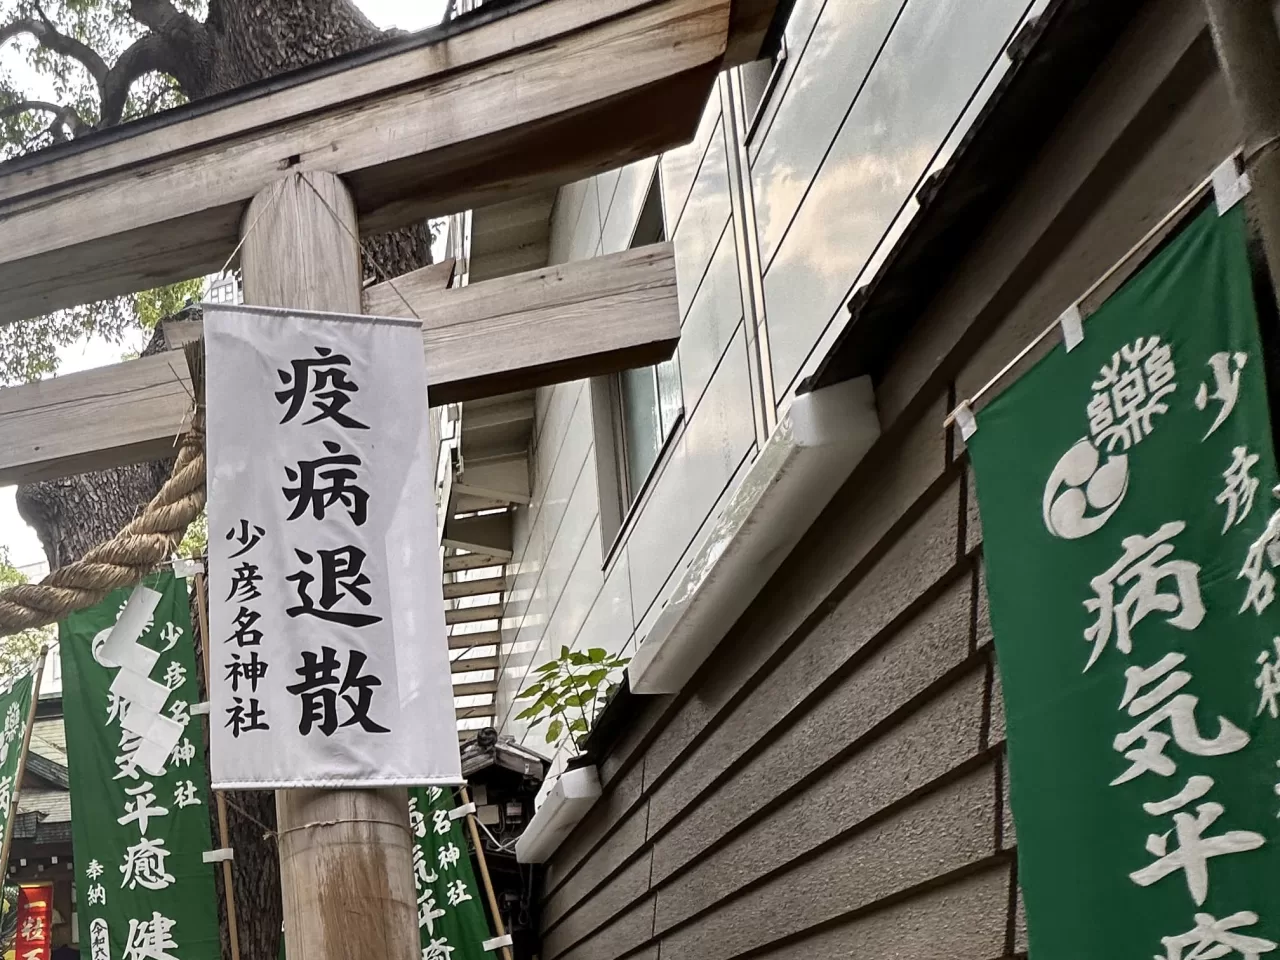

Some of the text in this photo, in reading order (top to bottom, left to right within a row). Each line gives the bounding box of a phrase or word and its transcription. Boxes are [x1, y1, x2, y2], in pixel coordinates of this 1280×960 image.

[224, 518, 270, 738] 少彦名神社
[274, 346, 391, 737] 疫病退散
[159, 621, 202, 809] 少彦名神社
[86, 859, 107, 906] 奉納
